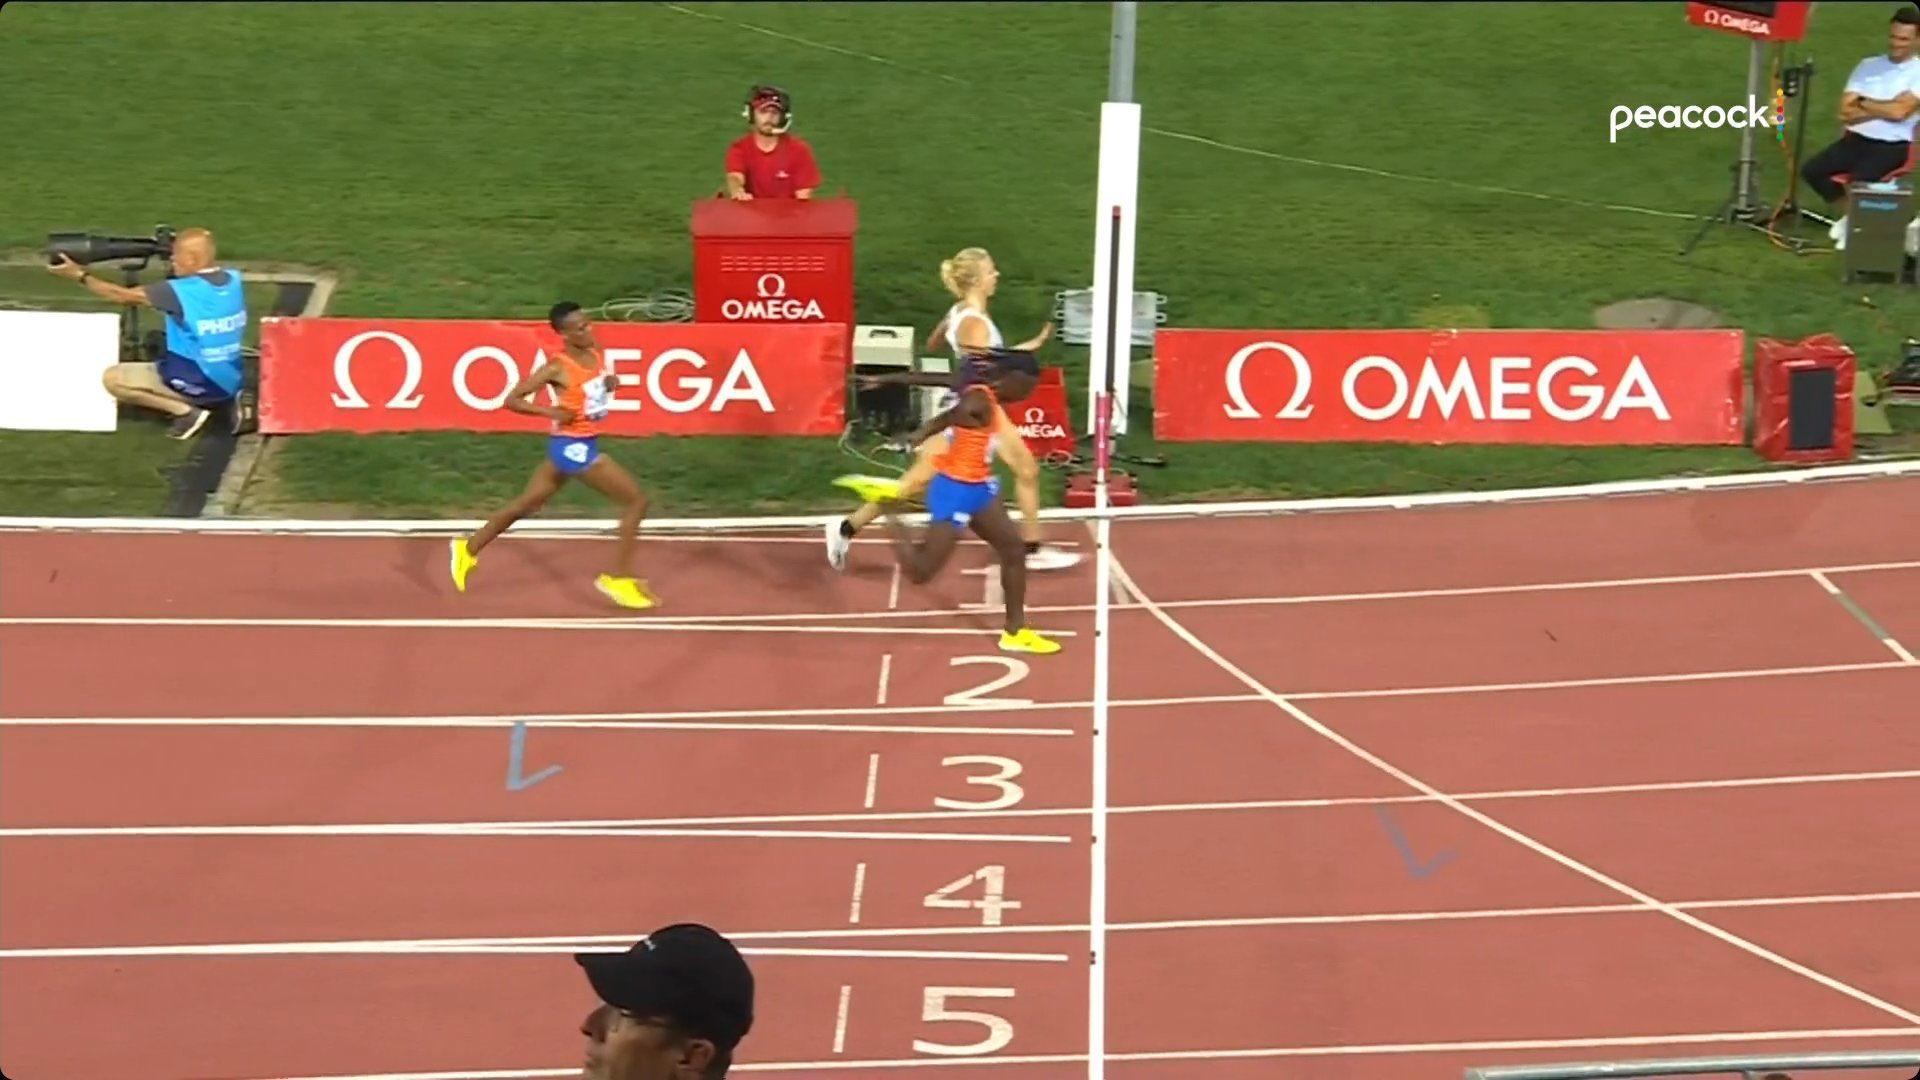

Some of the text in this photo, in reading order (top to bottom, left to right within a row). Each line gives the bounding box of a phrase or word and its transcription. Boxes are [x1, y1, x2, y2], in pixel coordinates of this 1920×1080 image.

[721, 298, 825, 320] OMEGA
[1341, 354, 1671, 421] OMEGA
[1014, 424, 1066, 438] MEGA
[943, 655, 1034, 706] 2
[934, 755, 1024, 810] 3
[923, 865, 1021, 925] 4
[912, 986, 1015, 1055] 5
